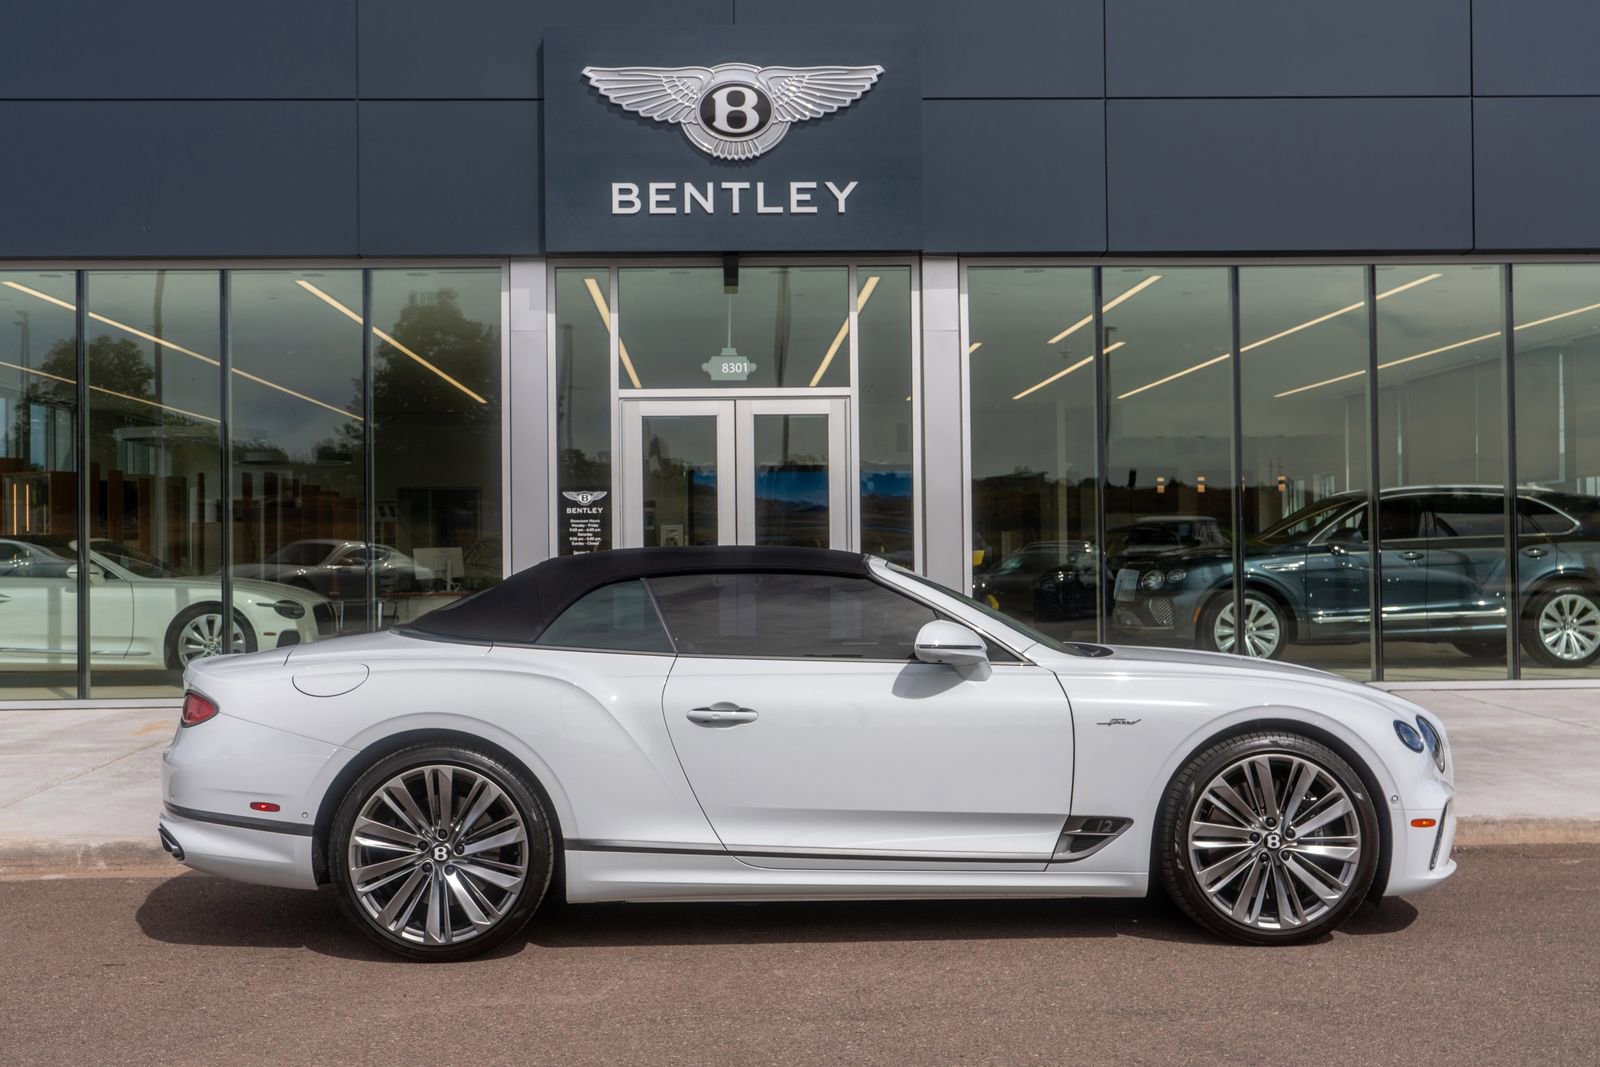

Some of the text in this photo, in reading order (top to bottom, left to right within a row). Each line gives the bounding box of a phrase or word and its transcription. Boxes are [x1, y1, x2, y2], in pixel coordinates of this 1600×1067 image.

[711, 86, 760, 133] B
[611, 181, 858, 215] BENTLEY
[721, 362, 747, 373] 8301
[1267, 834, 1281, 849] B
[433, 846, 448, 861] B
